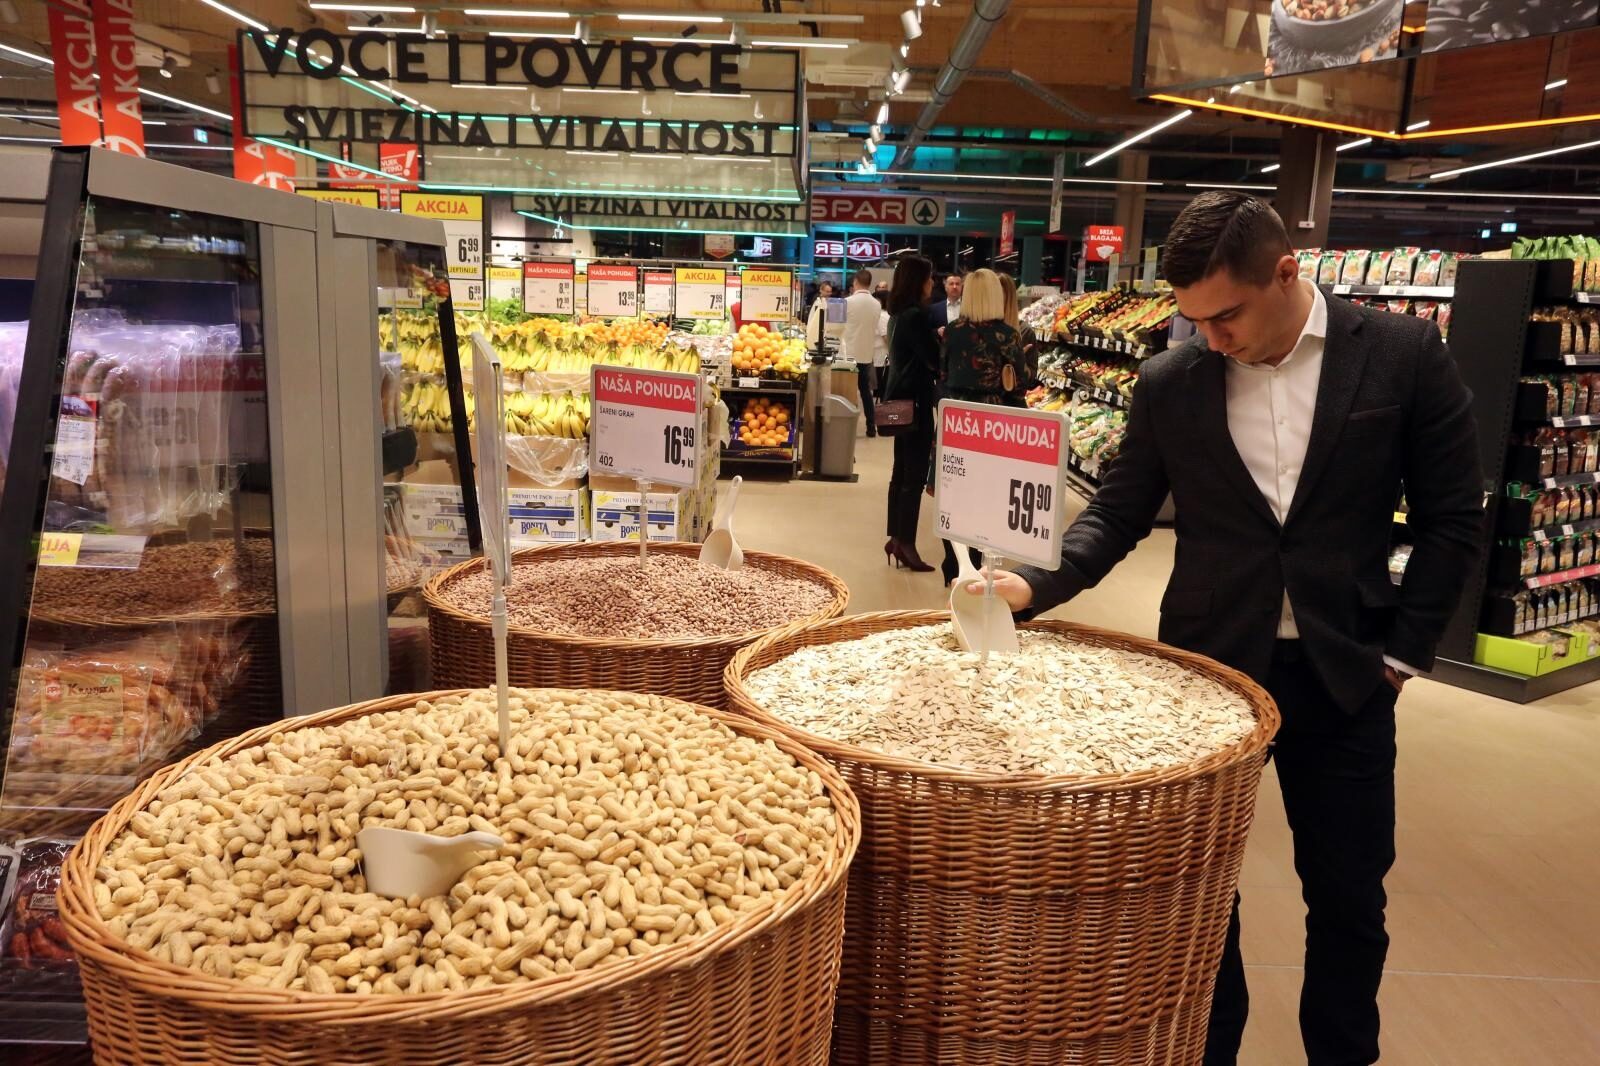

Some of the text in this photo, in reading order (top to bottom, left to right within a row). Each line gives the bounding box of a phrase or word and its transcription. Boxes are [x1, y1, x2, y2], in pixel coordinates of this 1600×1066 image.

[251, 14, 741, 94] VOĆE I POVRĆE
[508, 114, 517, 148] I
[530, 114, 780, 157] VITALNOST
[416, 199, 469, 214] AKCIJA
[653, 199, 659, 216] I
[666, 199, 800, 221] VITALNOST
[812, 198, 904, 220] SPAR
[685, 272, 717, 281] AKCIJA
[750, 275, 783, 283] AKCIJA
[600, 375, 696, 401] NAŠA PONUDA!
[600, 405, 635, 418] ŠARENI GRAH
[945, 412, 1055, 449] NAŠA PONUDA!
[599, 455, 613, 467] 402
[943, 453, 964, 466] BUČINE
[943, 464, 966, 477] KOŠTICE
[521, 521, 550, 535] BONITA
[940, 515, 950, 530] 96
